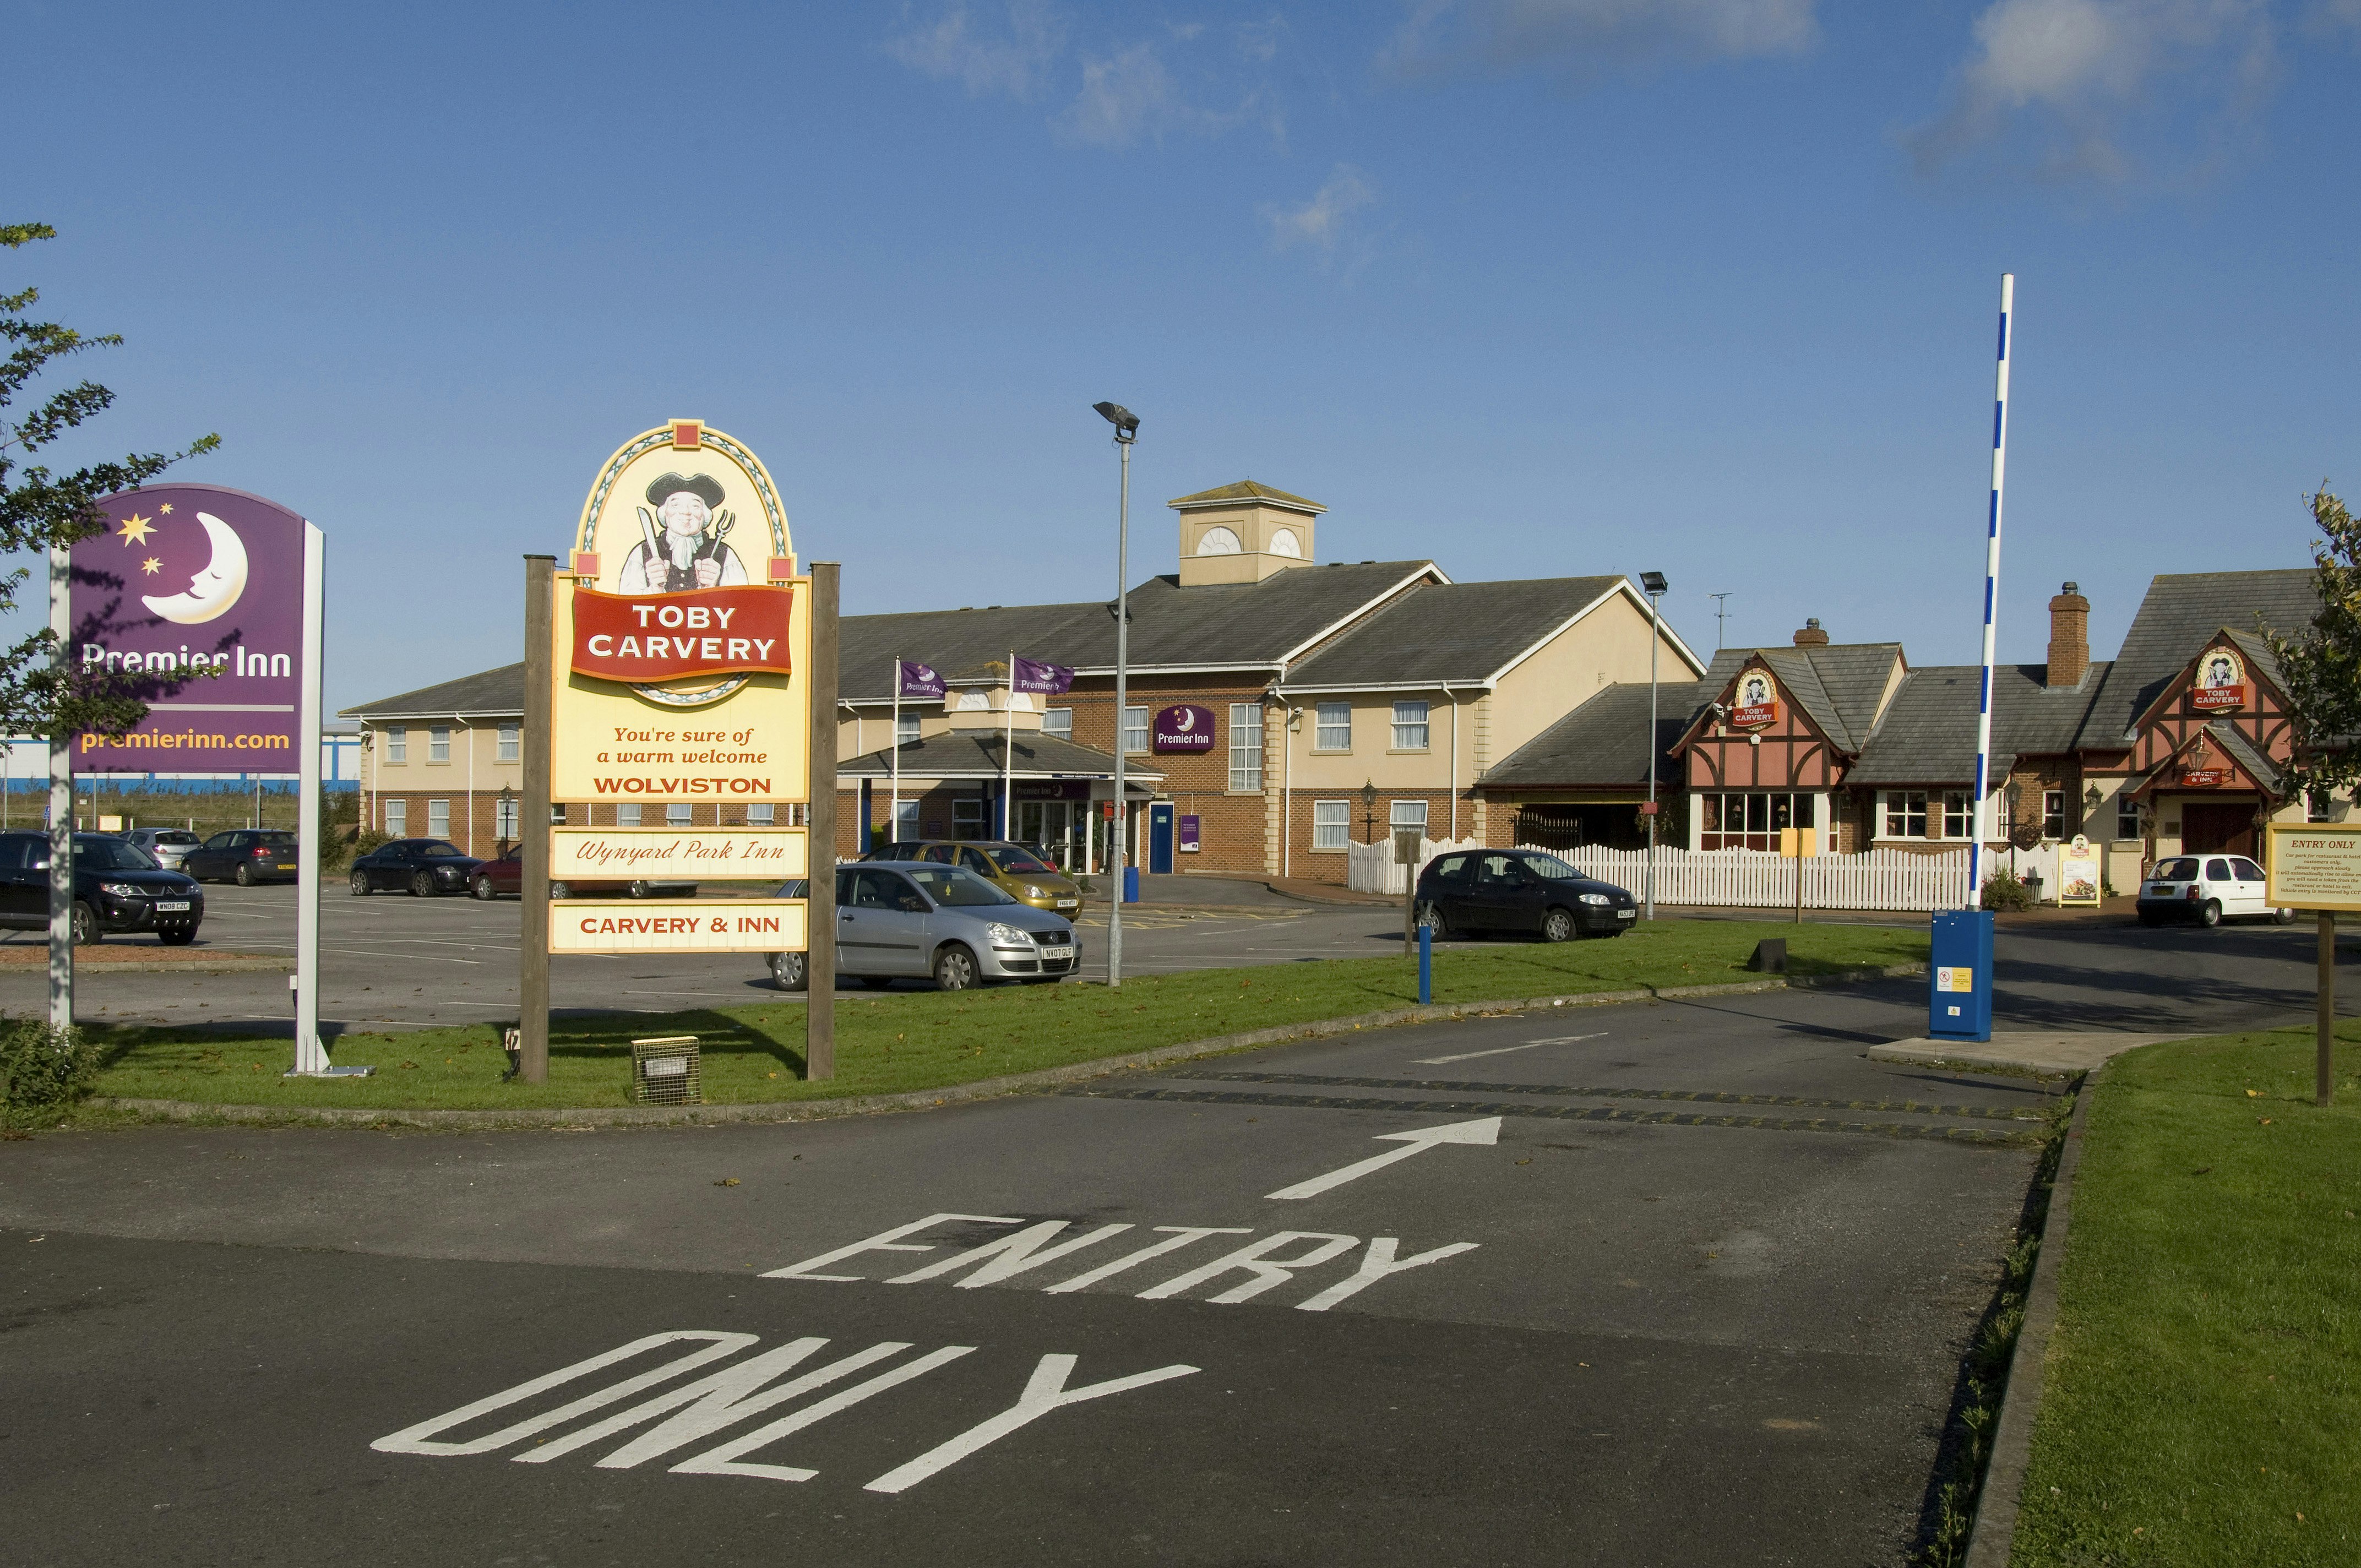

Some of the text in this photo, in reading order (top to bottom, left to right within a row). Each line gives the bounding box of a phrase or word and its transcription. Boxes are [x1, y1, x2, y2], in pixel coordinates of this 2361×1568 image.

[633, 605, 736, 629] TOBY
[587, 634, 775, 661] CARVERY
[83, 643, 291, 677] Premier Inn
[906, 682, 932, 691] Premier
[1021, 679, 1054, 690] Premier
[81, 728, 290, 754] premierinn.com
[614, 727, 754, 747] You're sure of
[1158, 733, 1209, 744] Premier Inn
[597, 749, 768, 764] a warm welcome
[594, 778, 771, 794] WOLVISTON
[576, 840, 785, 865] Wynyard Park Inn
[2291, 840, 2356, 849] ENTRY ONLY
[580, 918, 780, 934] CARVERY & INN
[1046, 948, 1071, 957] NV07 GLF
[756, 1212, 1482, 1310] ENTRY
[370, 1329, 1203, 1494] ONLY
